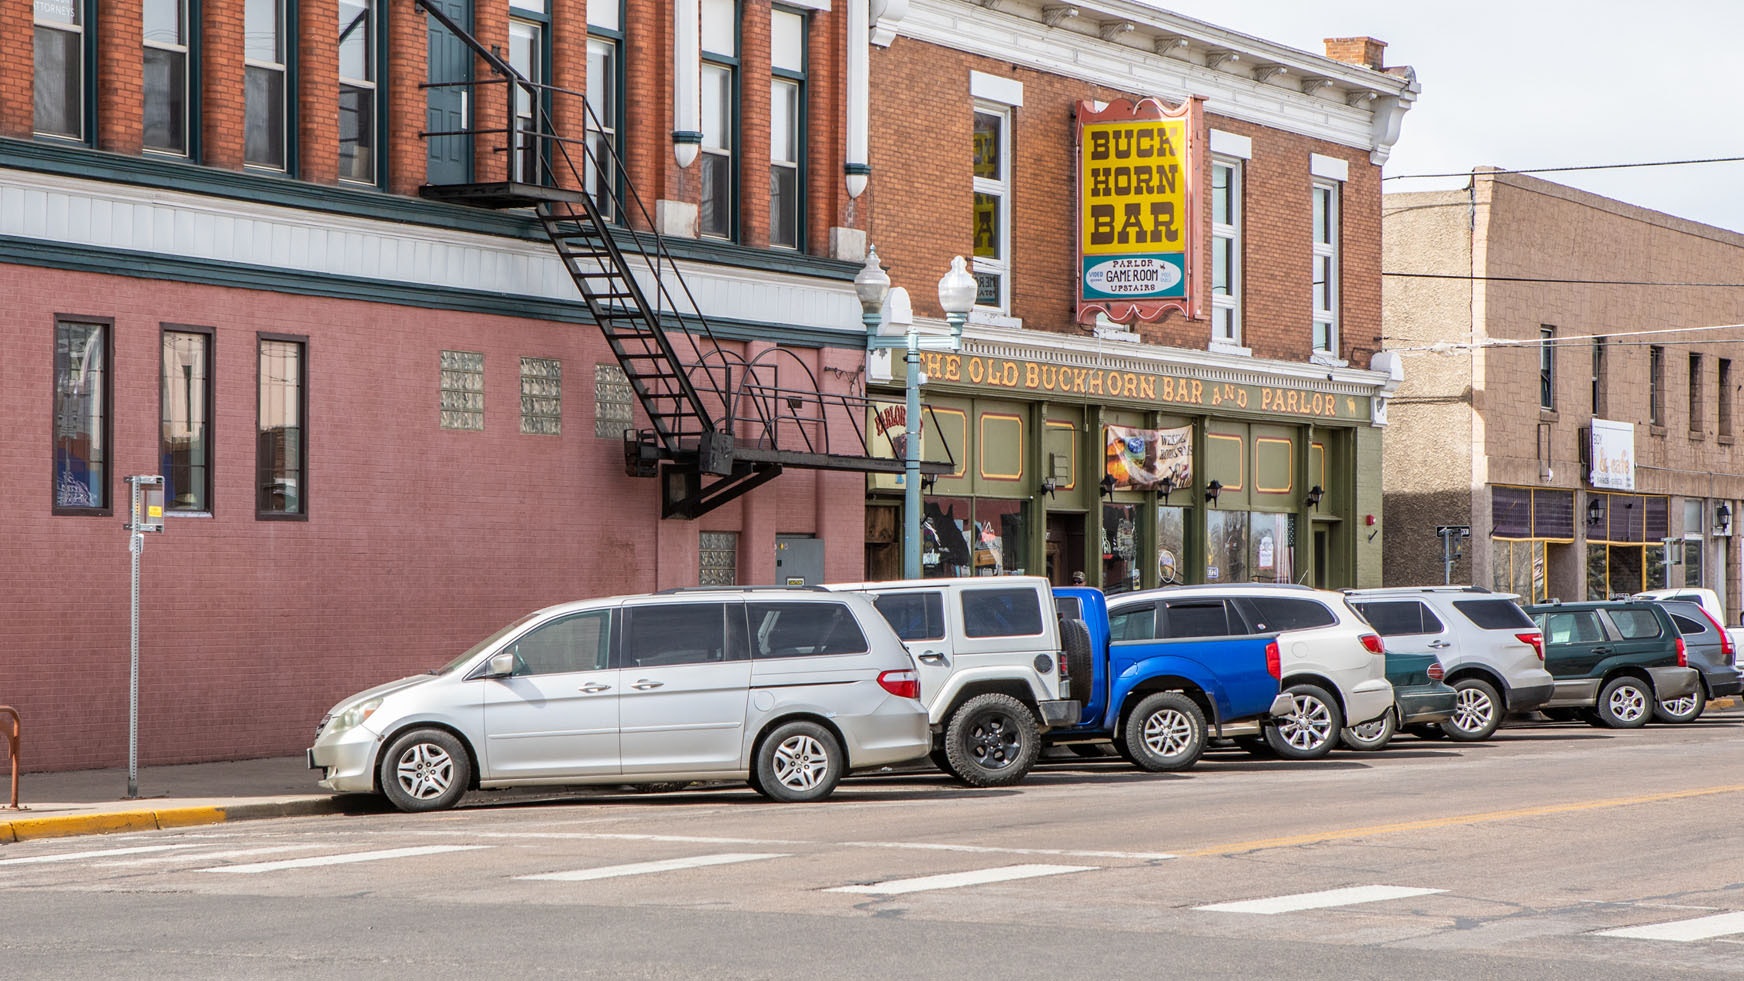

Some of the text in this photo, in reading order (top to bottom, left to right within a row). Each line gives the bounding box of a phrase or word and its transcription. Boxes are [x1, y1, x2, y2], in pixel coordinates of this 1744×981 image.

[35, 1, 74, 17] TTORNEYS
[1091, 128, 1177, 160] BUCK
[1091, 164, 1178, 197] HORN
[1090, 202, 1178, 245] BAR
[1113, 259, 1154, 268] PARLOR
[1106, 269, 1132, 283] GAME
[1132, 269, 1158, 282] ROOM
[1110, 284, 1156, 292] UPSTAIRS
[968, 356, 1019, 387] OLD
[1025, 362, 1157, 401] BUCKHORN
[1163, 376, 1203, 404] BAR
[1212, 383, 1248, 409] AND
[1261, 387, 1336, 417] PARLOR
